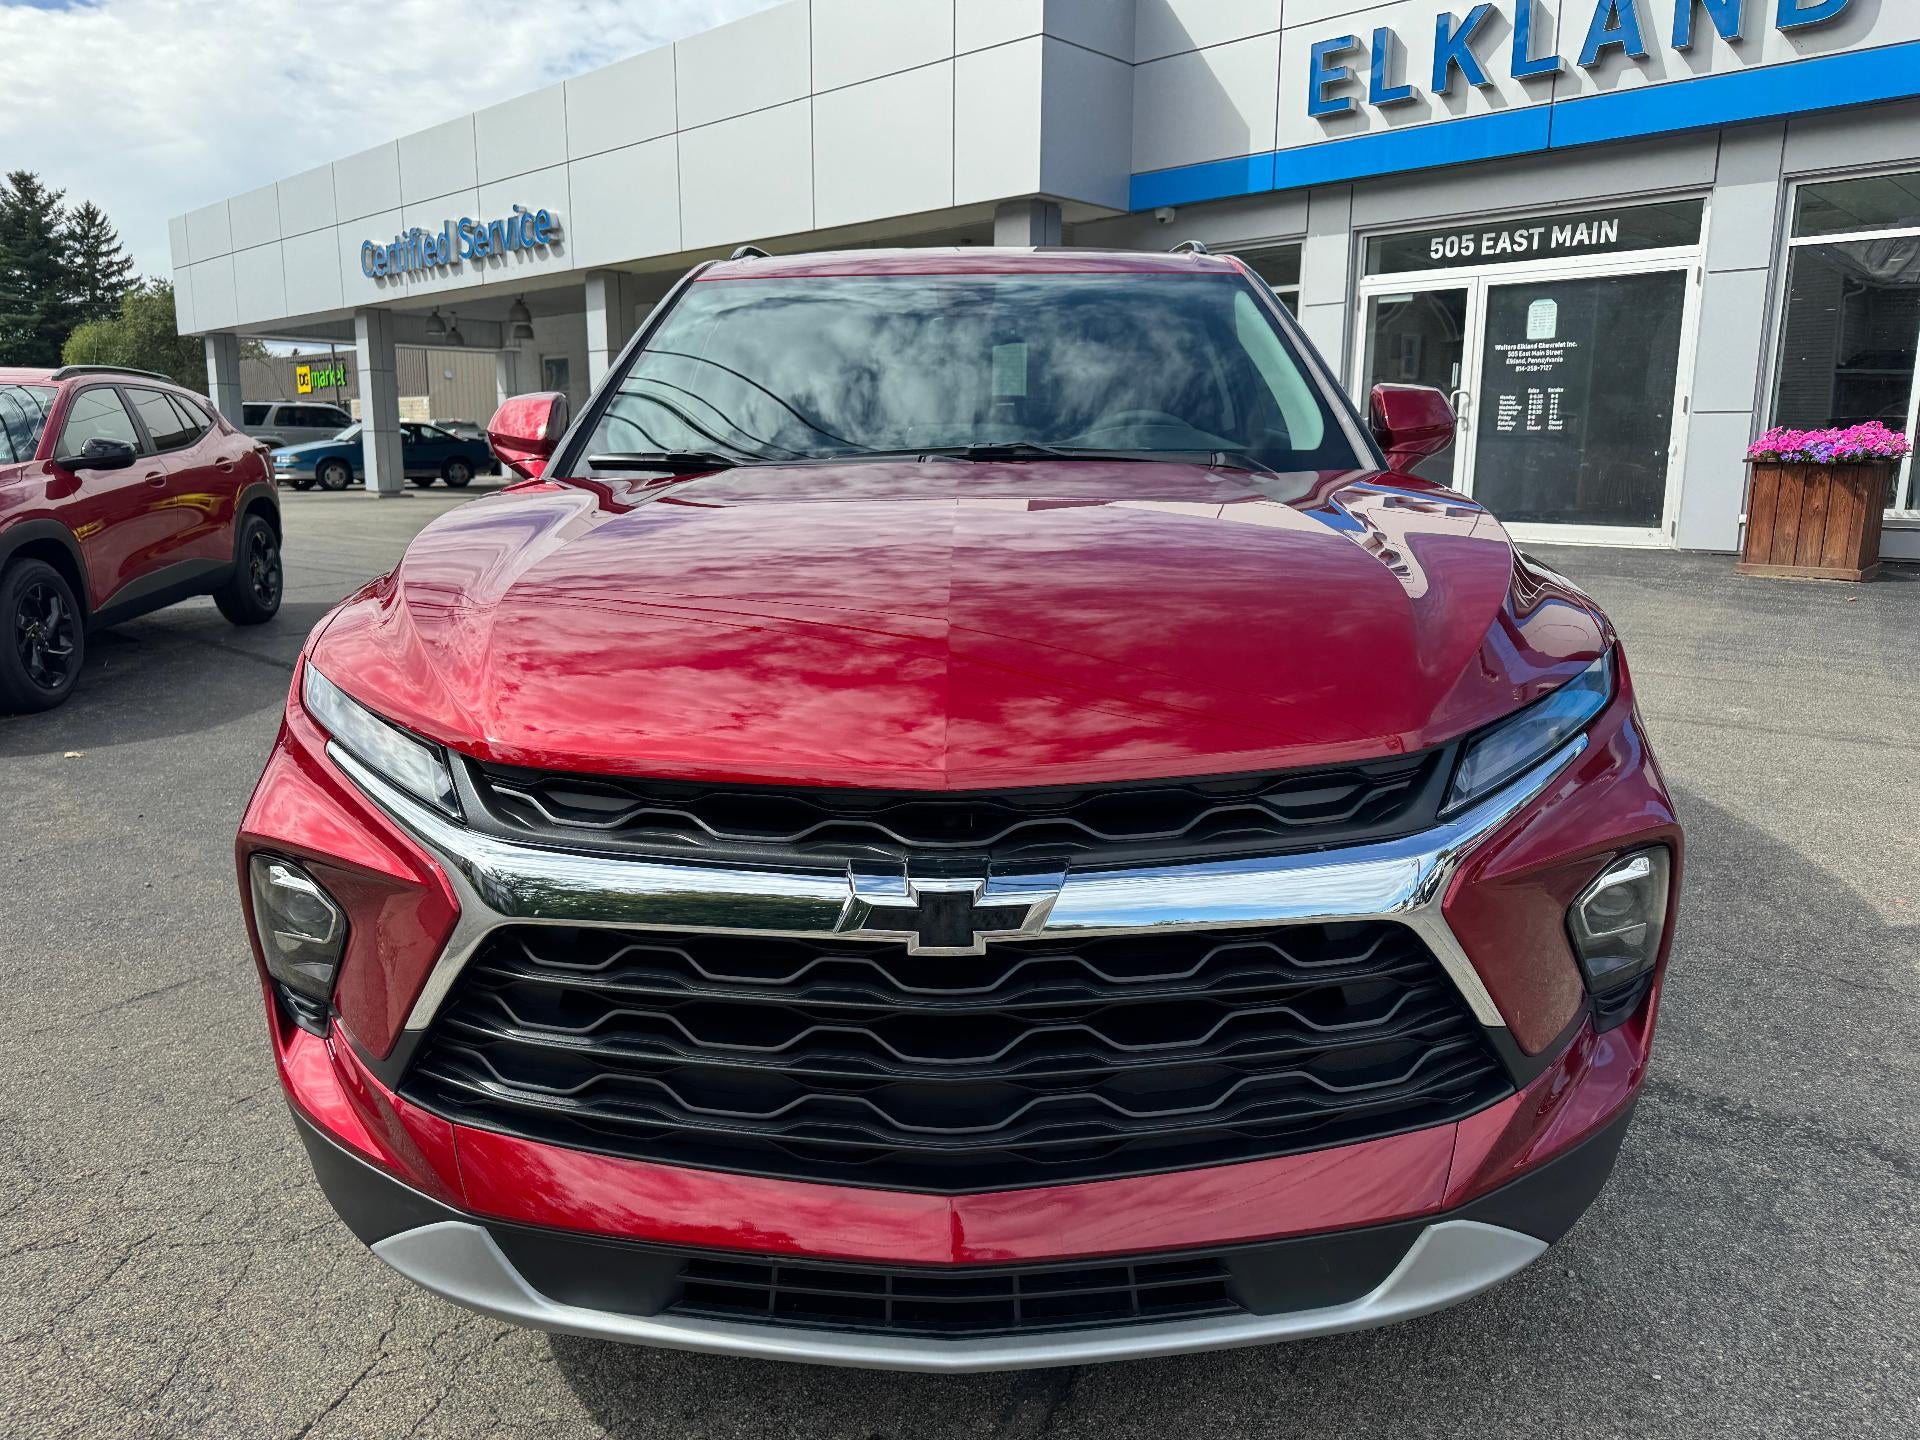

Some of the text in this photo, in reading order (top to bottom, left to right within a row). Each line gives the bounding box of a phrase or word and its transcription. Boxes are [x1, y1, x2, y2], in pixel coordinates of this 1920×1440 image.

[360, 204, 556, 278] Certified Service
[1430, 219, 1619, 260] 505 EAST MAIN
[1538, 341, 1566, 349] Chevrolet
[1527, 356, 1564, 364] Pennsylvania
